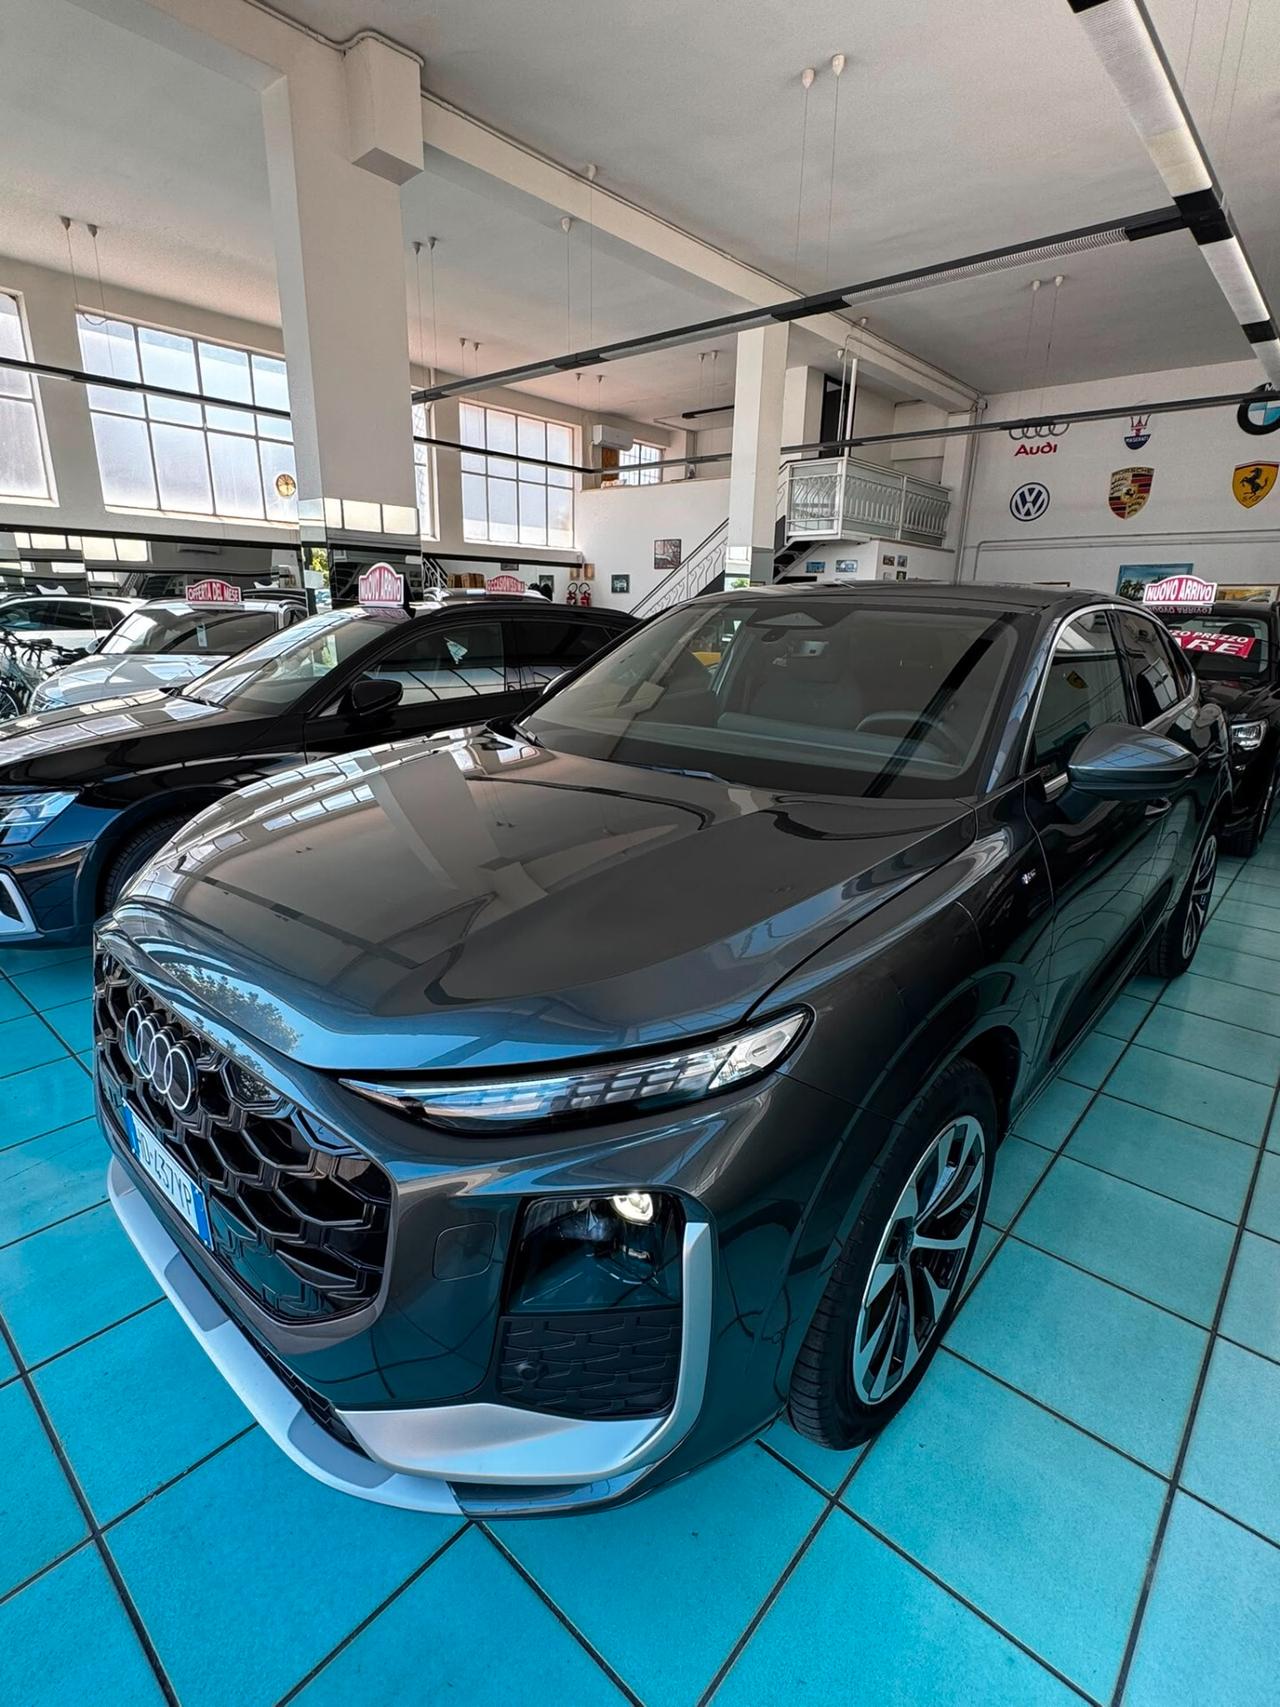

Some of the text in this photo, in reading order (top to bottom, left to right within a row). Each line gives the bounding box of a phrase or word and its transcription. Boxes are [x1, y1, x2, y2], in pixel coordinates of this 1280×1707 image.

[1014, 442, 1058, 456] Audi
[188, 582, 239, 602] OFFERTA DEL MESE
[1147, 577, 1212, 601] NUOVO ARRIVO
[1192, 631, 1249, 643] PREZZO
